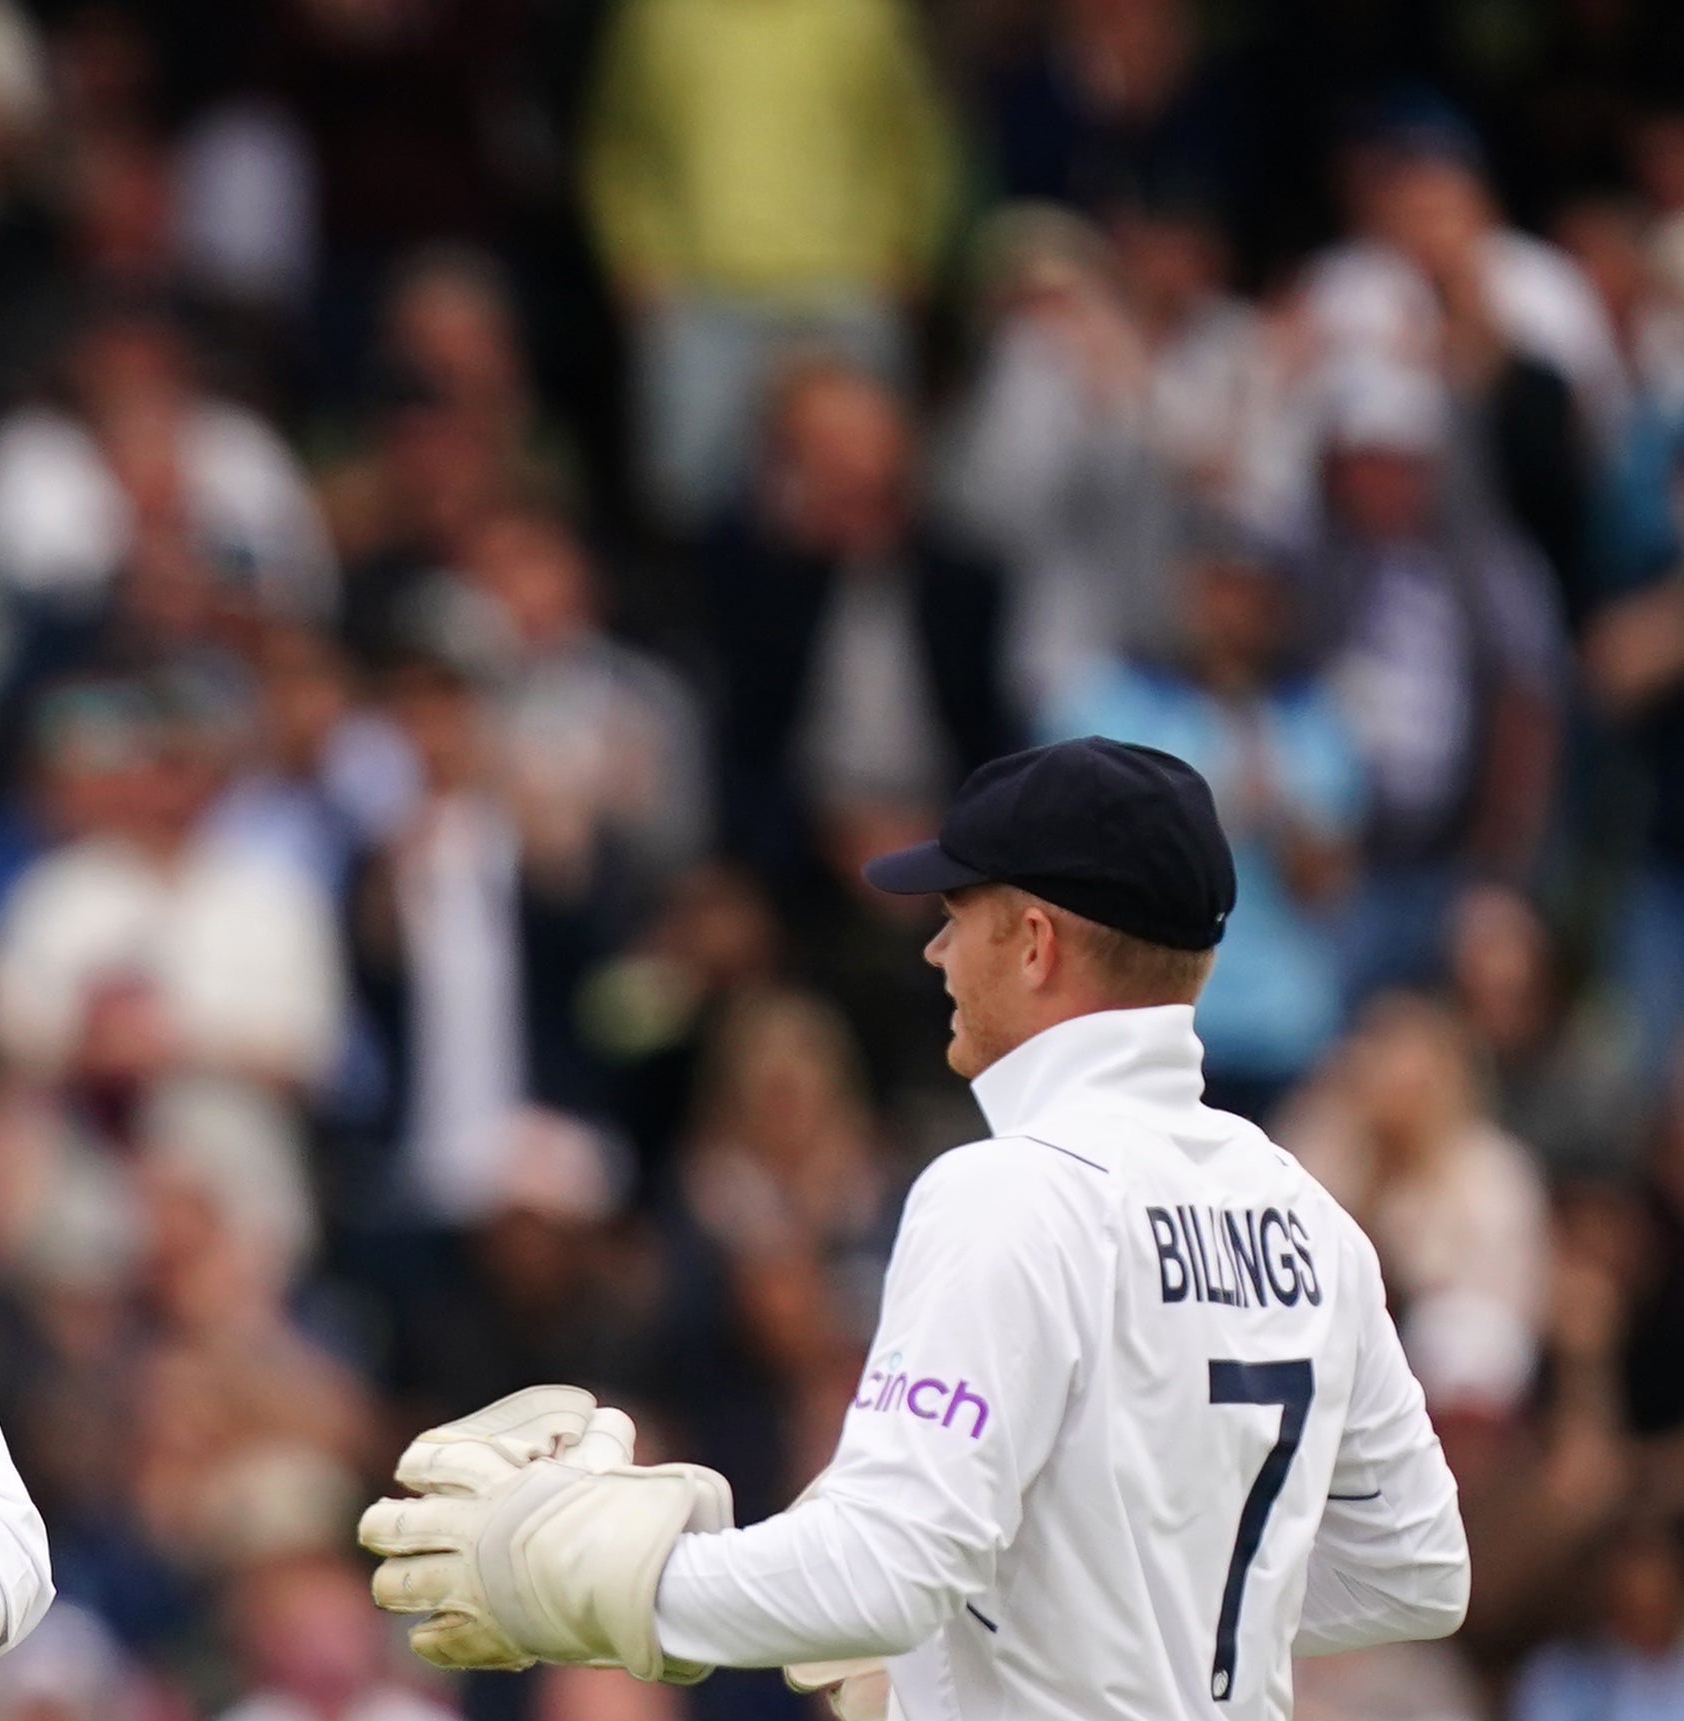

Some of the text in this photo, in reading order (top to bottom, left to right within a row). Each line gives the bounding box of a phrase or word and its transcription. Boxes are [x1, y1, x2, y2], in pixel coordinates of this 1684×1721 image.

[1145, 1203, 1323, 1309] BILLINGS
[852, 1351, 990, 1440] cinch
[1208, 1357, 1314, 1701] 7
